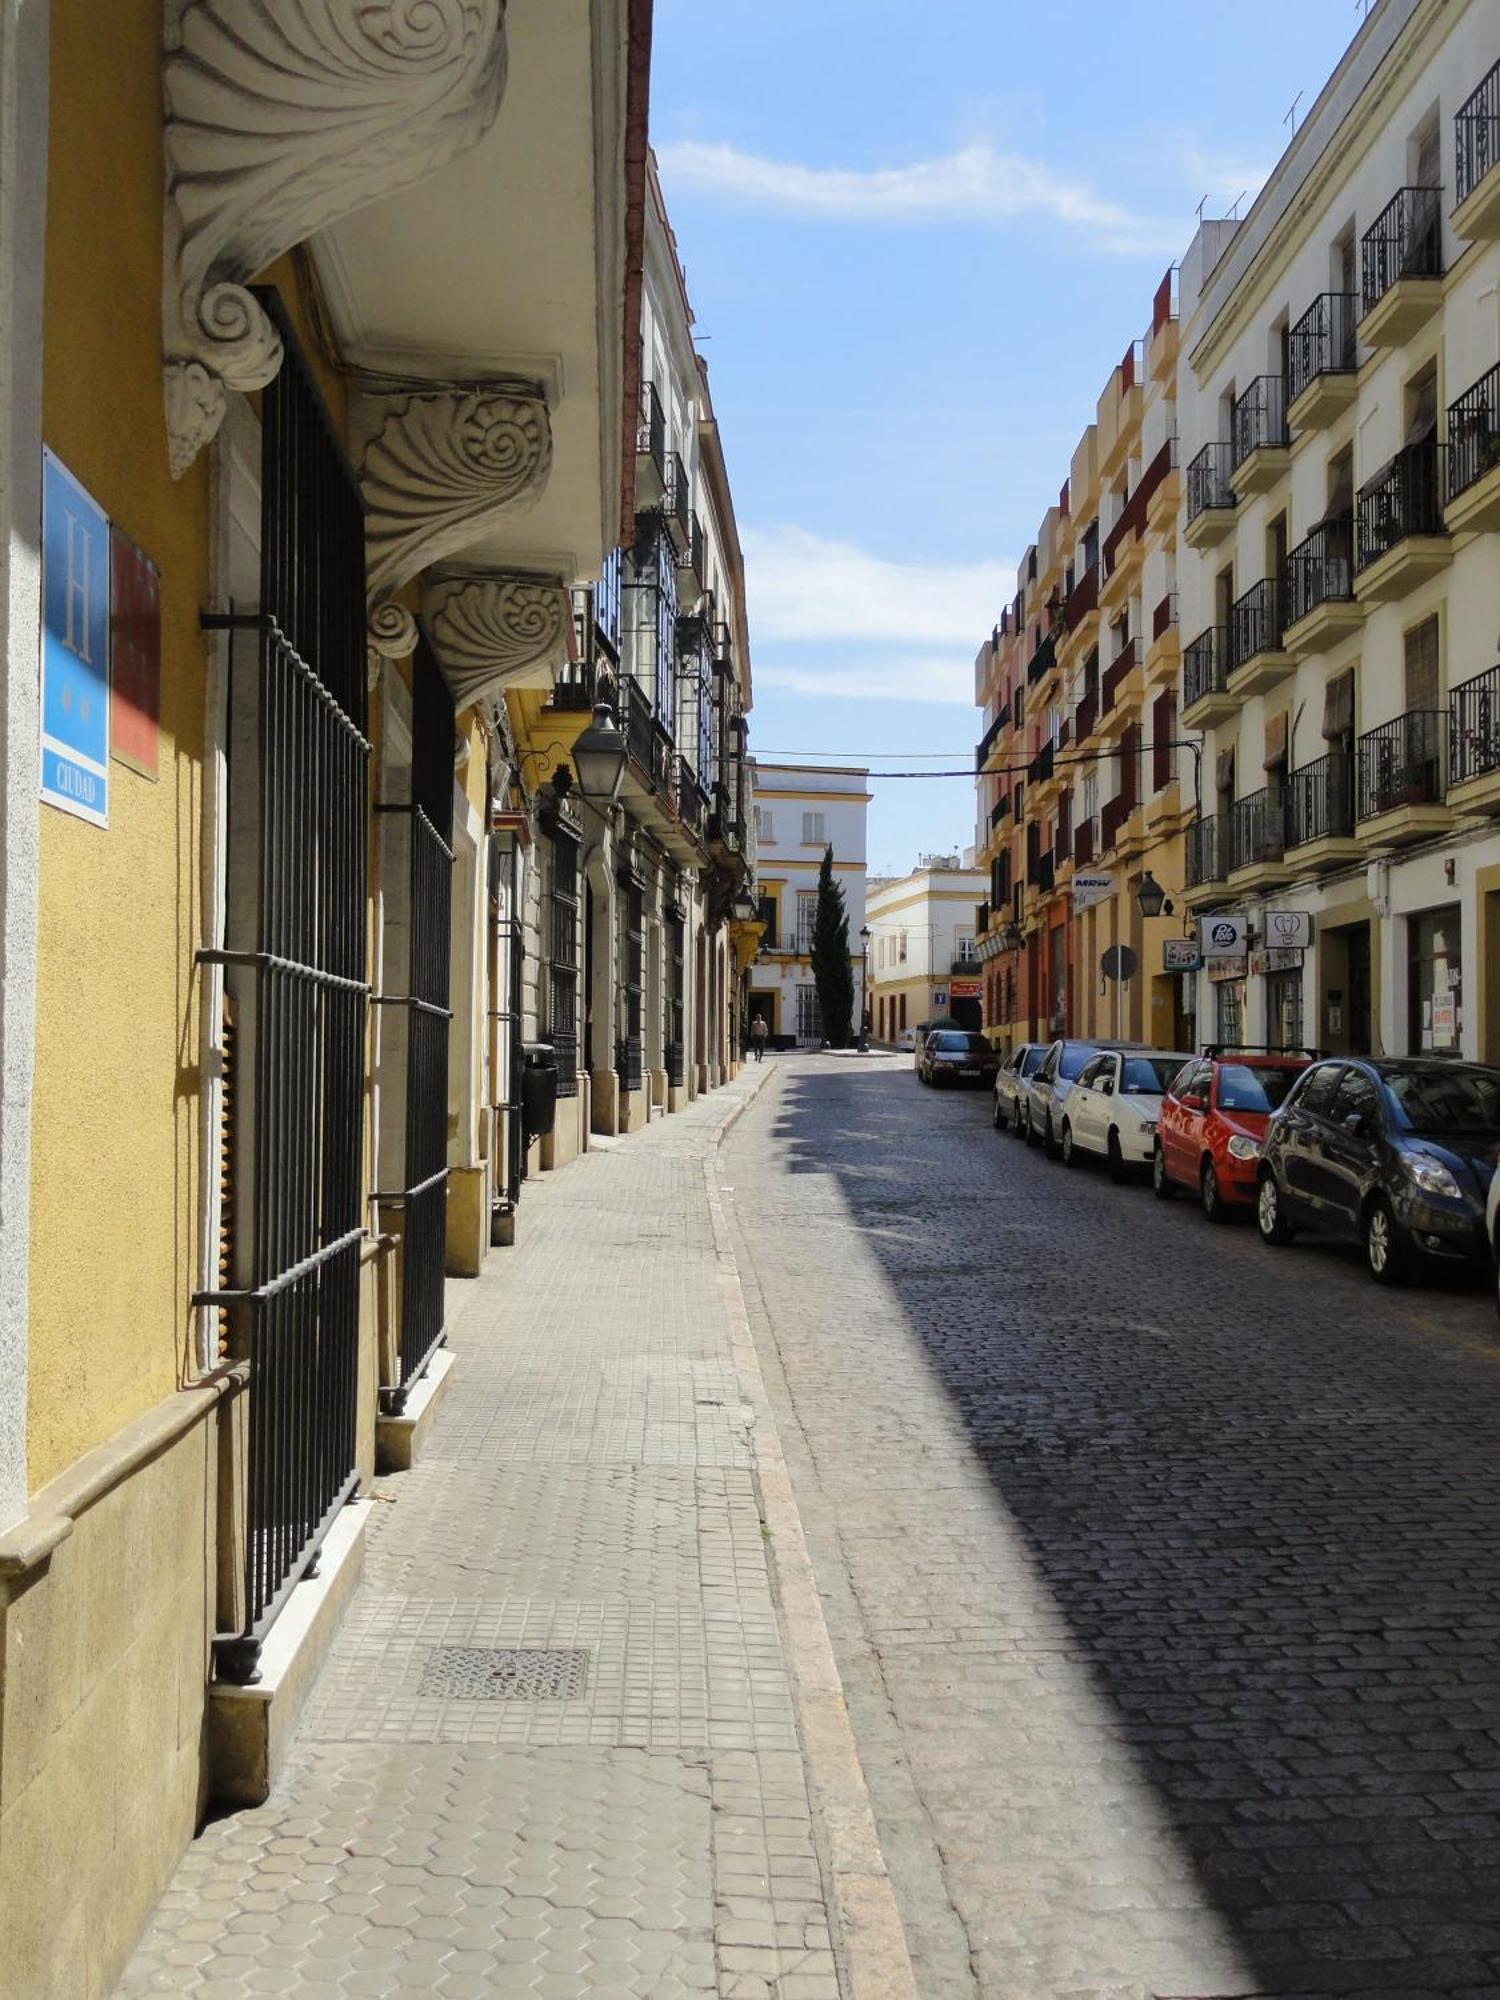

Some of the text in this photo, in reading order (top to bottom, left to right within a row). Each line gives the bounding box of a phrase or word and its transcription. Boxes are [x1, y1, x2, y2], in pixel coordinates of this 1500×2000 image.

[62, 510, 94, 662] H
[57, 761, 96, 803] CIUDAD
[1075, 879, 1112, 887] MRW
[1214, 924, 1235, 942] Polo
